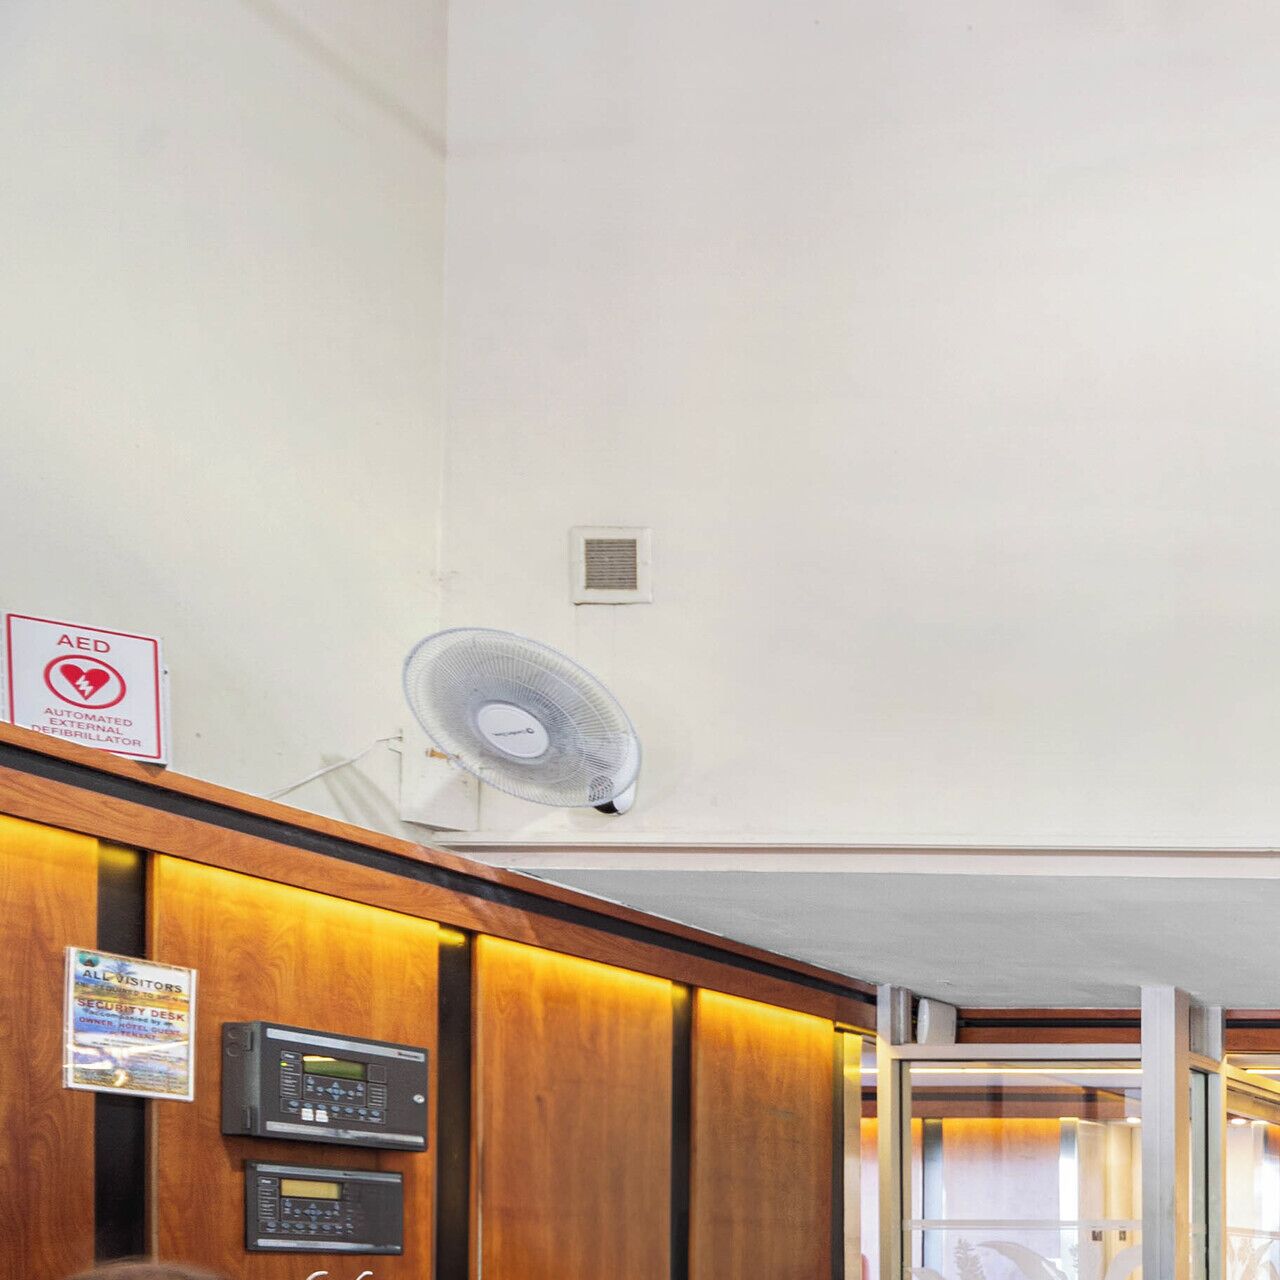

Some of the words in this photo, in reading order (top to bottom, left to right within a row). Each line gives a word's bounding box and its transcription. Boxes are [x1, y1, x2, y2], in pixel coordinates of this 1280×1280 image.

[57, 633, 112, 654] AED
[44, 707, 133, 728] AUTOMATED
[49, 717, 124, 736] EXTERNAL
[31, 724, 142, 747] DEFIBRILLATOR
[83, 970, 109, 982] ALL
[115, 974, 183, 994] VISITORS
[77, 999, 146, 1016] SECURITY
[150, 1009, 185, 1022] DESK
